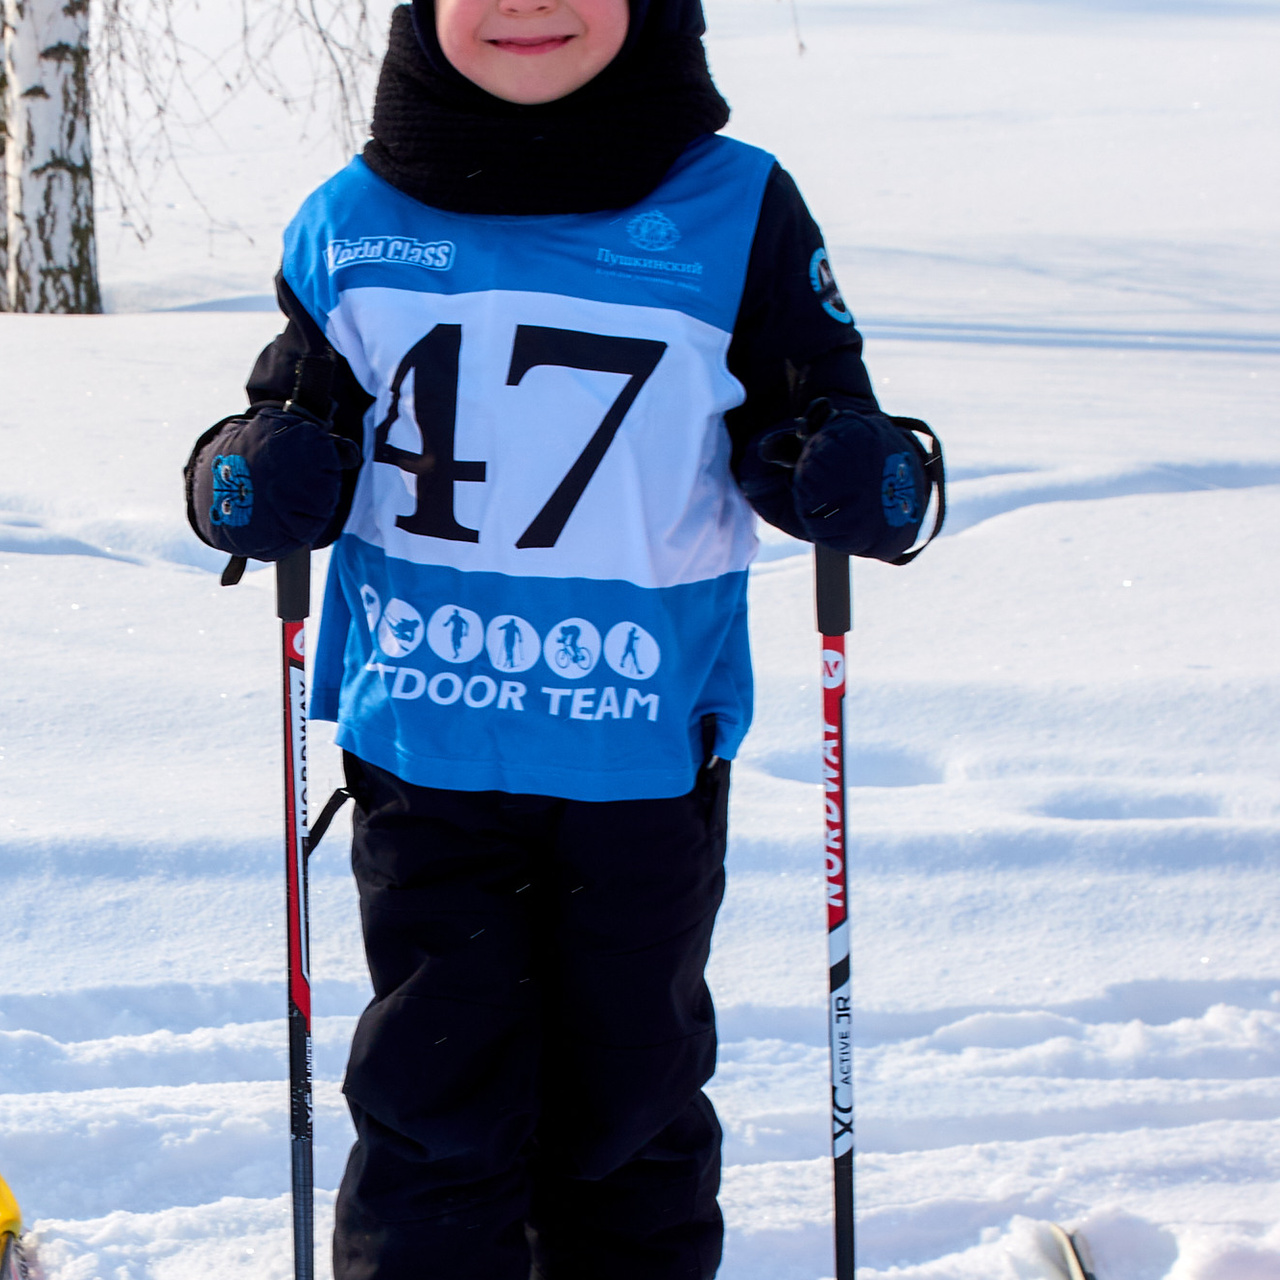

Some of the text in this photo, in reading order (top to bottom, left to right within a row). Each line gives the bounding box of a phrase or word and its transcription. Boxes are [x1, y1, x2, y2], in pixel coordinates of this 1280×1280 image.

[386, 240, 450, 267] Class
[373, 322, 668, 549] 47
[541, 685, 661, 722] TEAM
[823, 723, 844, 908] NORDWAY
[835, 995, 852, 1024] JR
[838, 1030, 852, 1085] ACTIVE
